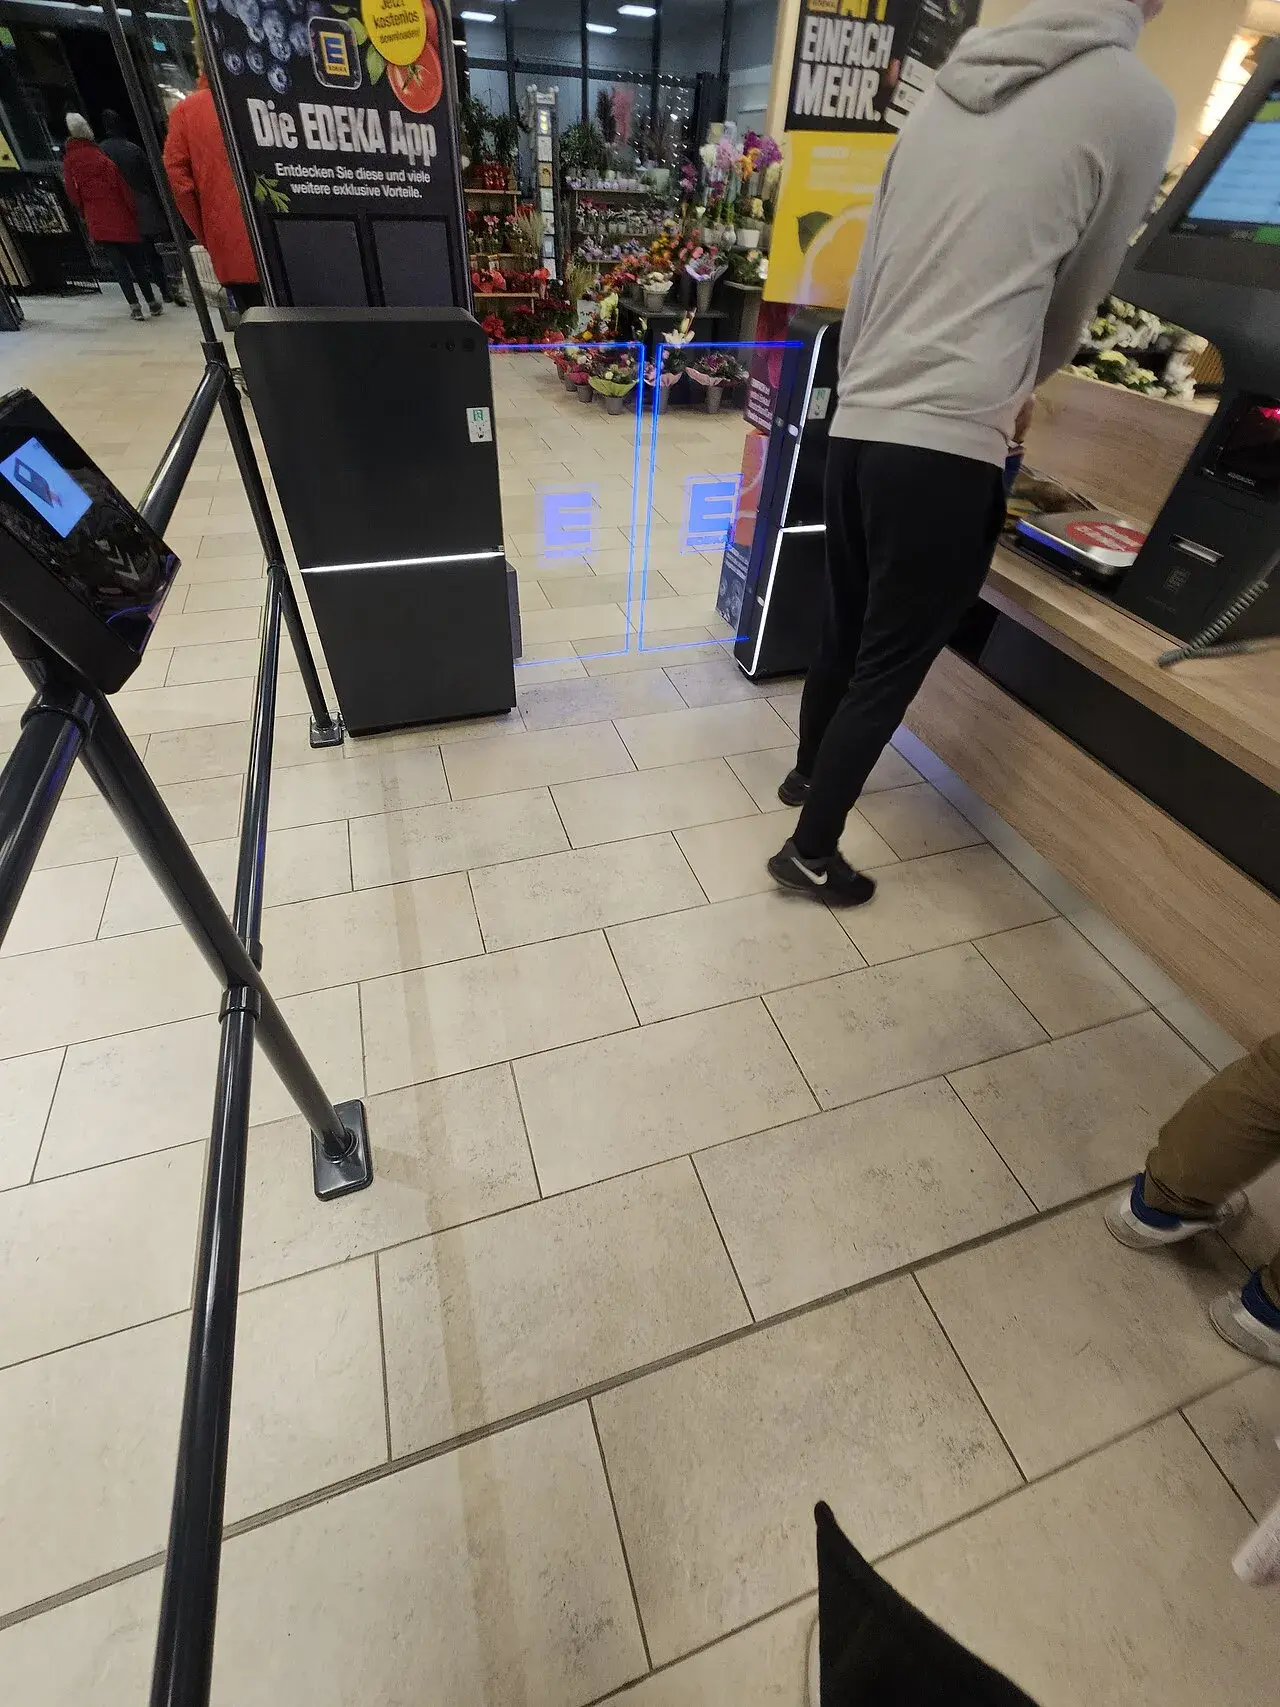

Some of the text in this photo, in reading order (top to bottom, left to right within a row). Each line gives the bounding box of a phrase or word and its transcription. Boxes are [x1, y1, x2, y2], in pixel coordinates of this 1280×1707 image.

[372, 10, 420, 29] kostenlos
[802, 15, 895, 69] EINFACH
[793, 62, 882, 122] MEHR.
[247, 98, 438, 167] Die EDEKA App
[275, 162, 431, 184] Entdecken Sie diese und viele
[290, 182, 423, 199] weitere exklusive Vorteile.
